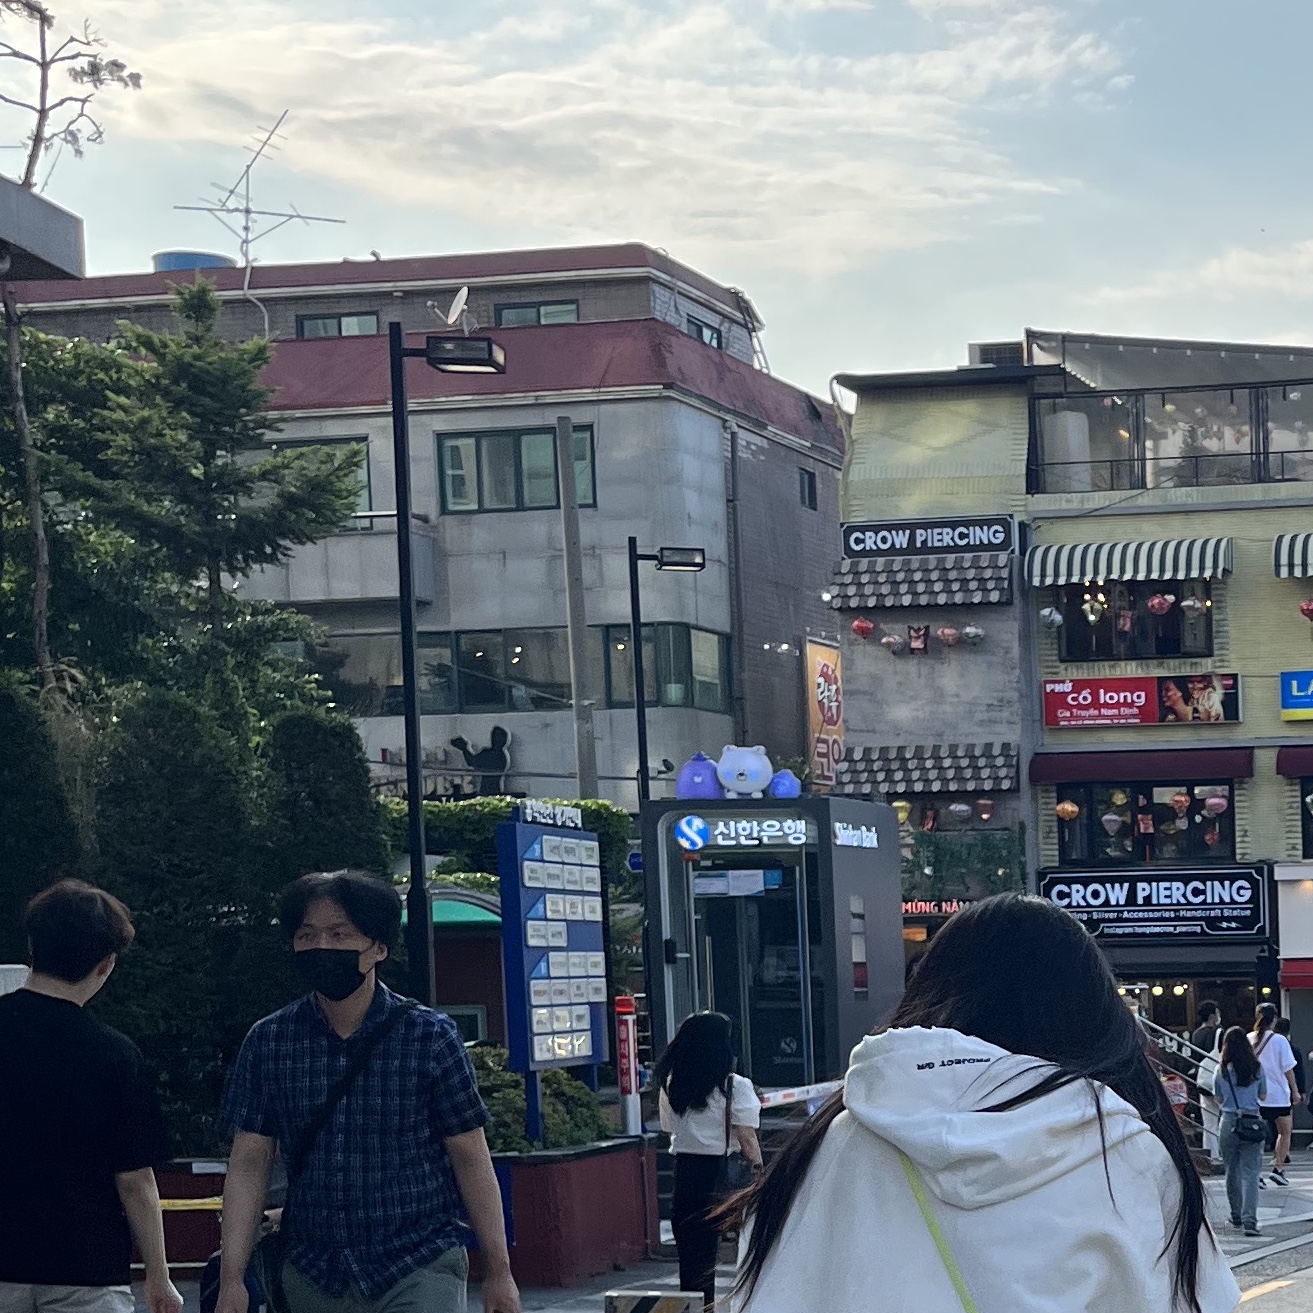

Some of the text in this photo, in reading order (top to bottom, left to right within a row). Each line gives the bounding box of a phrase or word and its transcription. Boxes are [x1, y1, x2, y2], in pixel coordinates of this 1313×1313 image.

[849, 524, 1005, 551] CROW PIERCING
[1099, 688, 1146, 707] long
[713, 819, 807, 846] 신한은행
[1050, 879, 1252, 907] CROW PIERCING
[1122, 910, 1175, 919] Accessories
[938, 1057, 992, 1067] PROJECT
